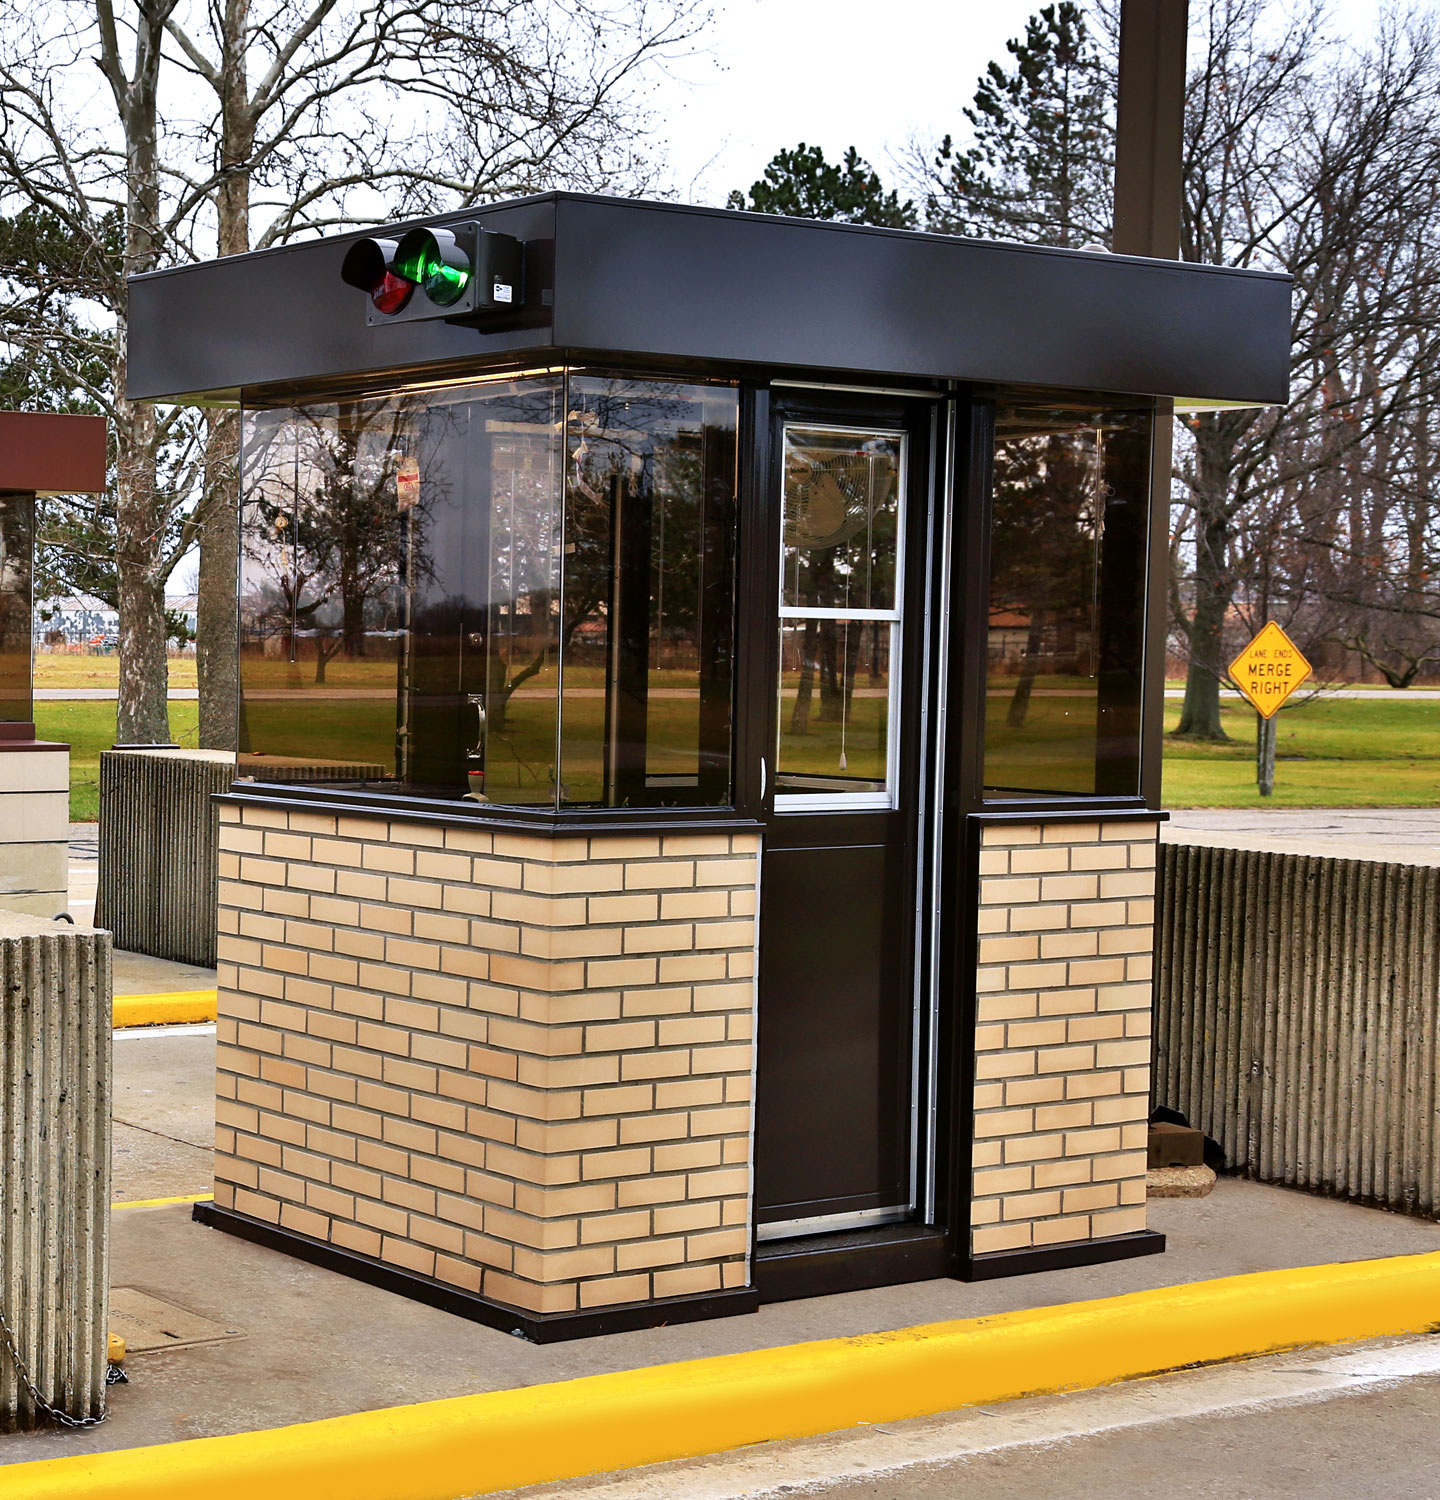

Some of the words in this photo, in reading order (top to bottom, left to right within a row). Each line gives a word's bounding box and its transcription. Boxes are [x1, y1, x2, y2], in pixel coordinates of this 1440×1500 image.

[1249, 649, 1268, 659] LANE
[1274, 649, 1292, 659] ENDS
[1248, 663, 1292, 677] MERGE
[1250, 681, 1289, 694] RIGHT
